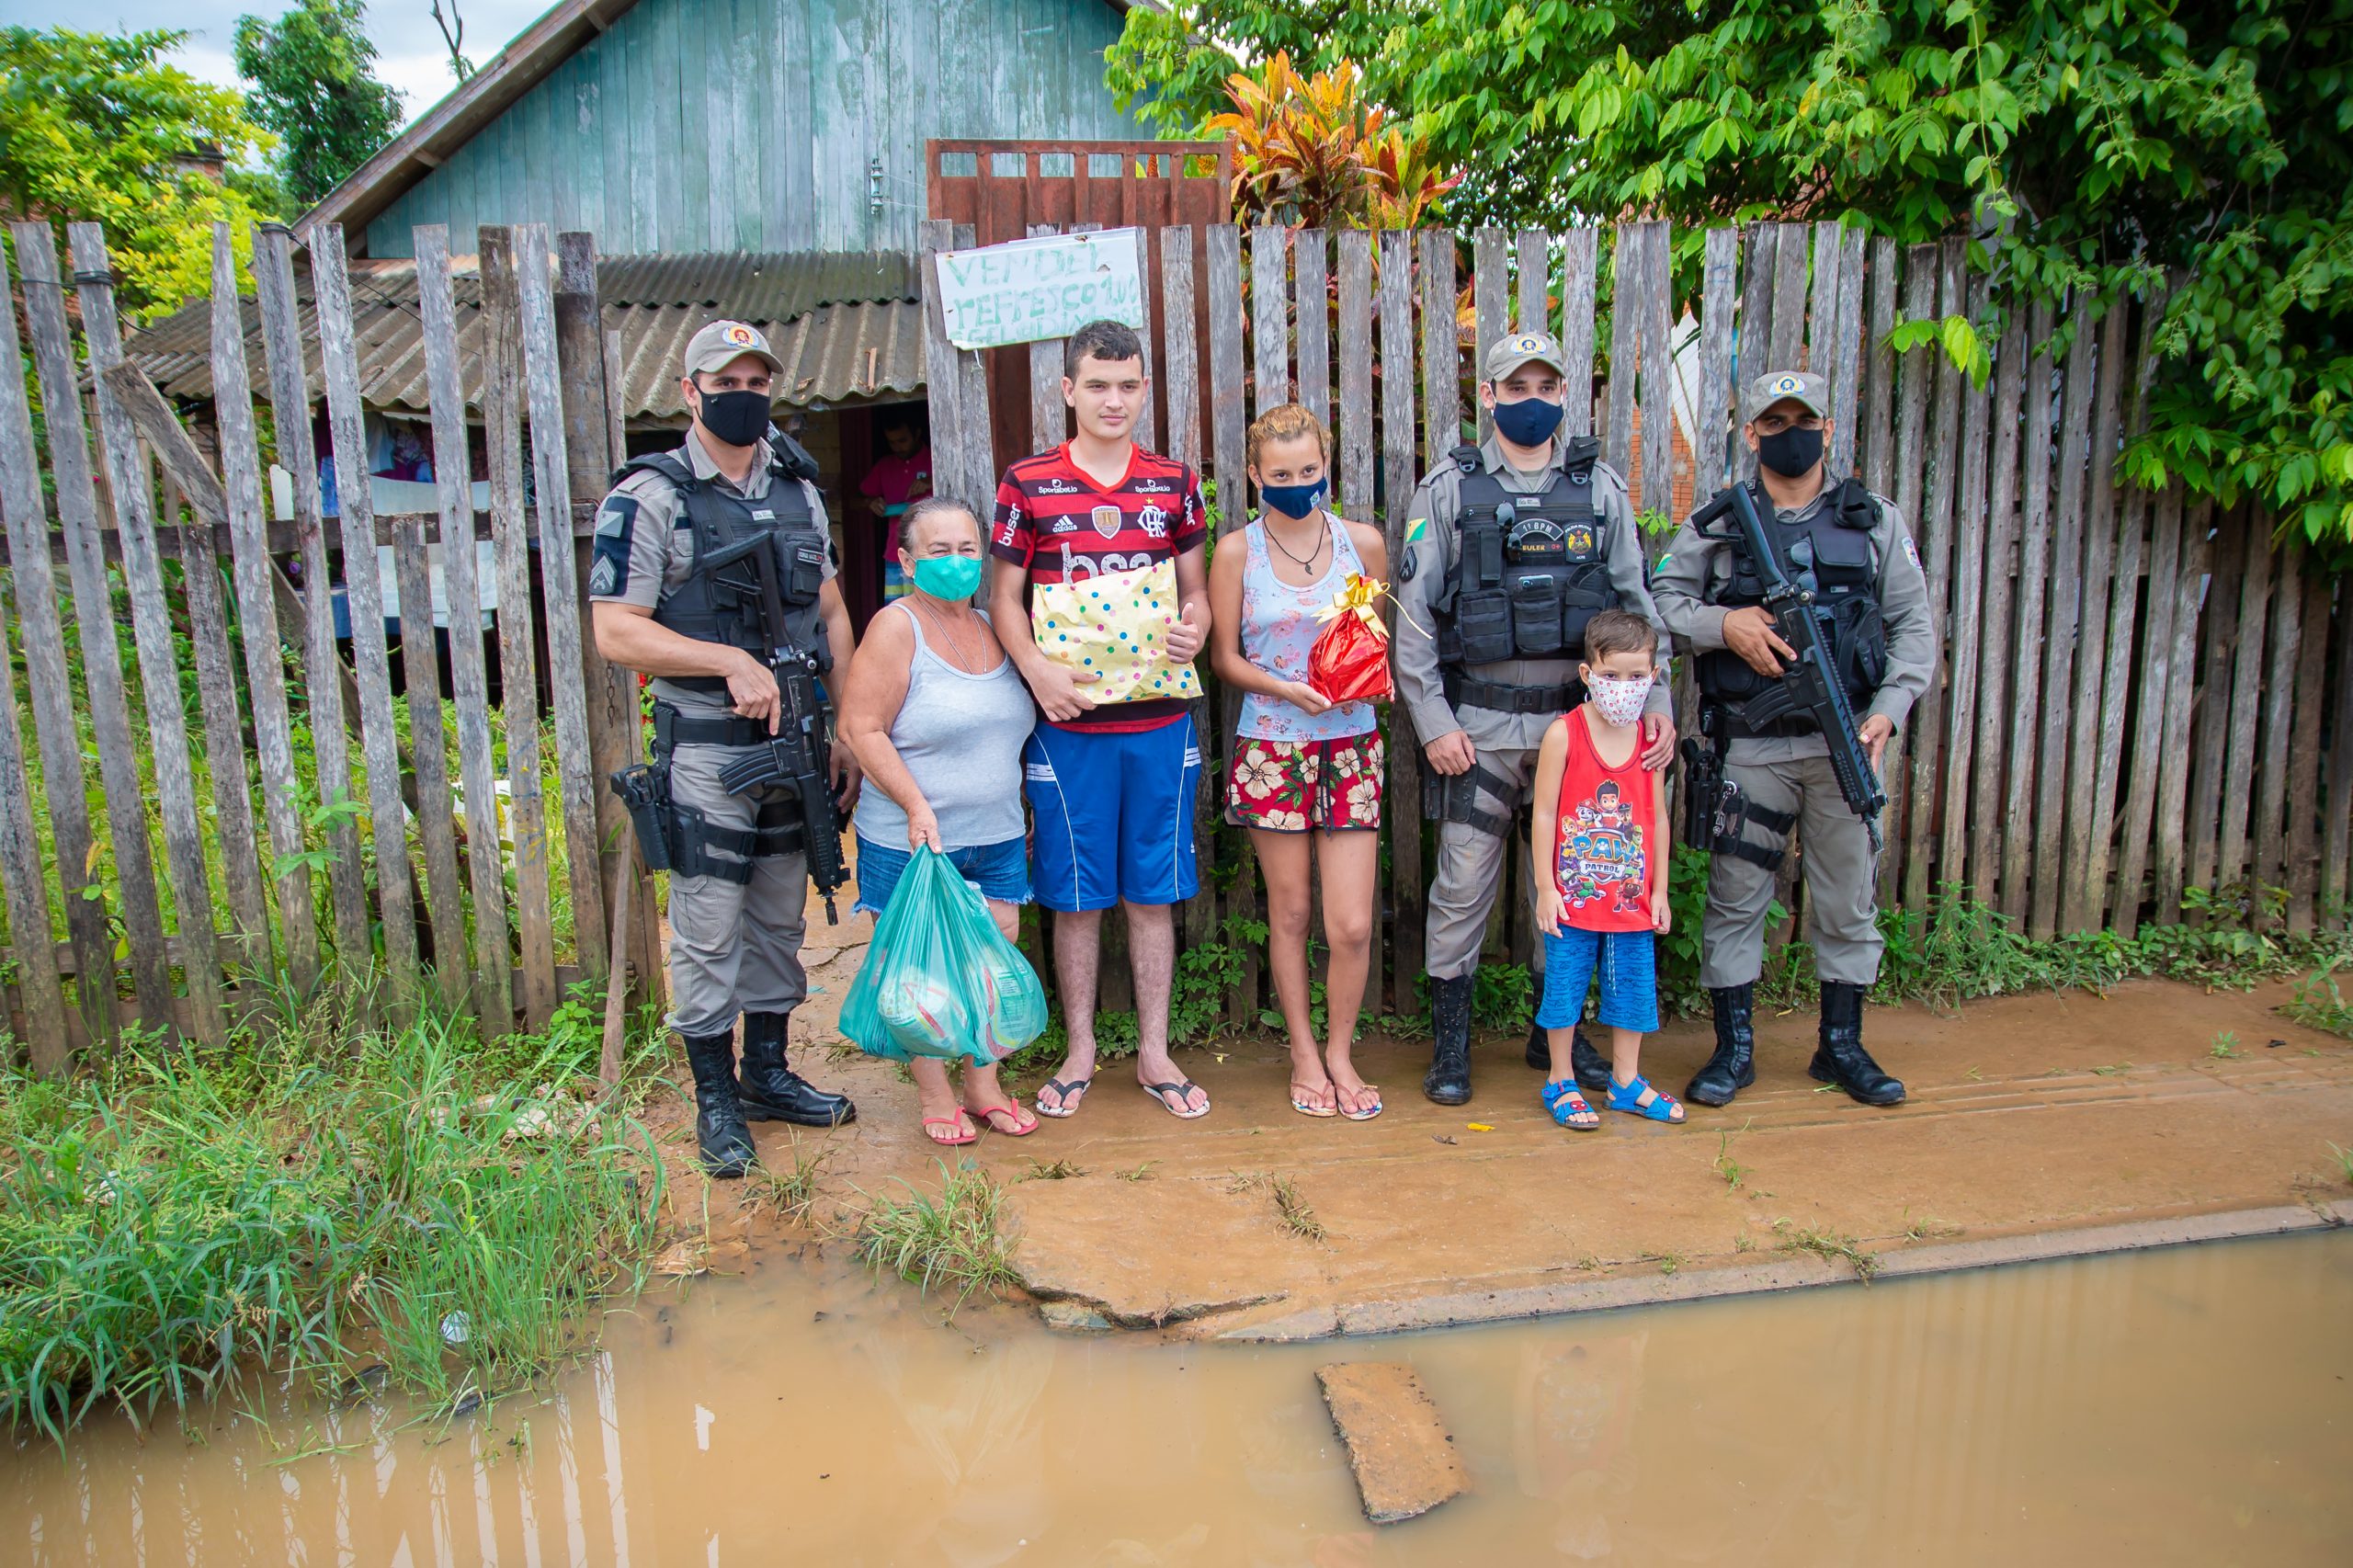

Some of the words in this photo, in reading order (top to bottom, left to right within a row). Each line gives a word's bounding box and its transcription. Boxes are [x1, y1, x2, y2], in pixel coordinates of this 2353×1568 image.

[998, 503, 1021, 547] buser
[1052, 524, 1078, 533] adidas
[1534, 521, 1552, 534] BPM
[1571, 835, 1637, 864] PAW
[1585, 863, 1620, 874] PATROL
